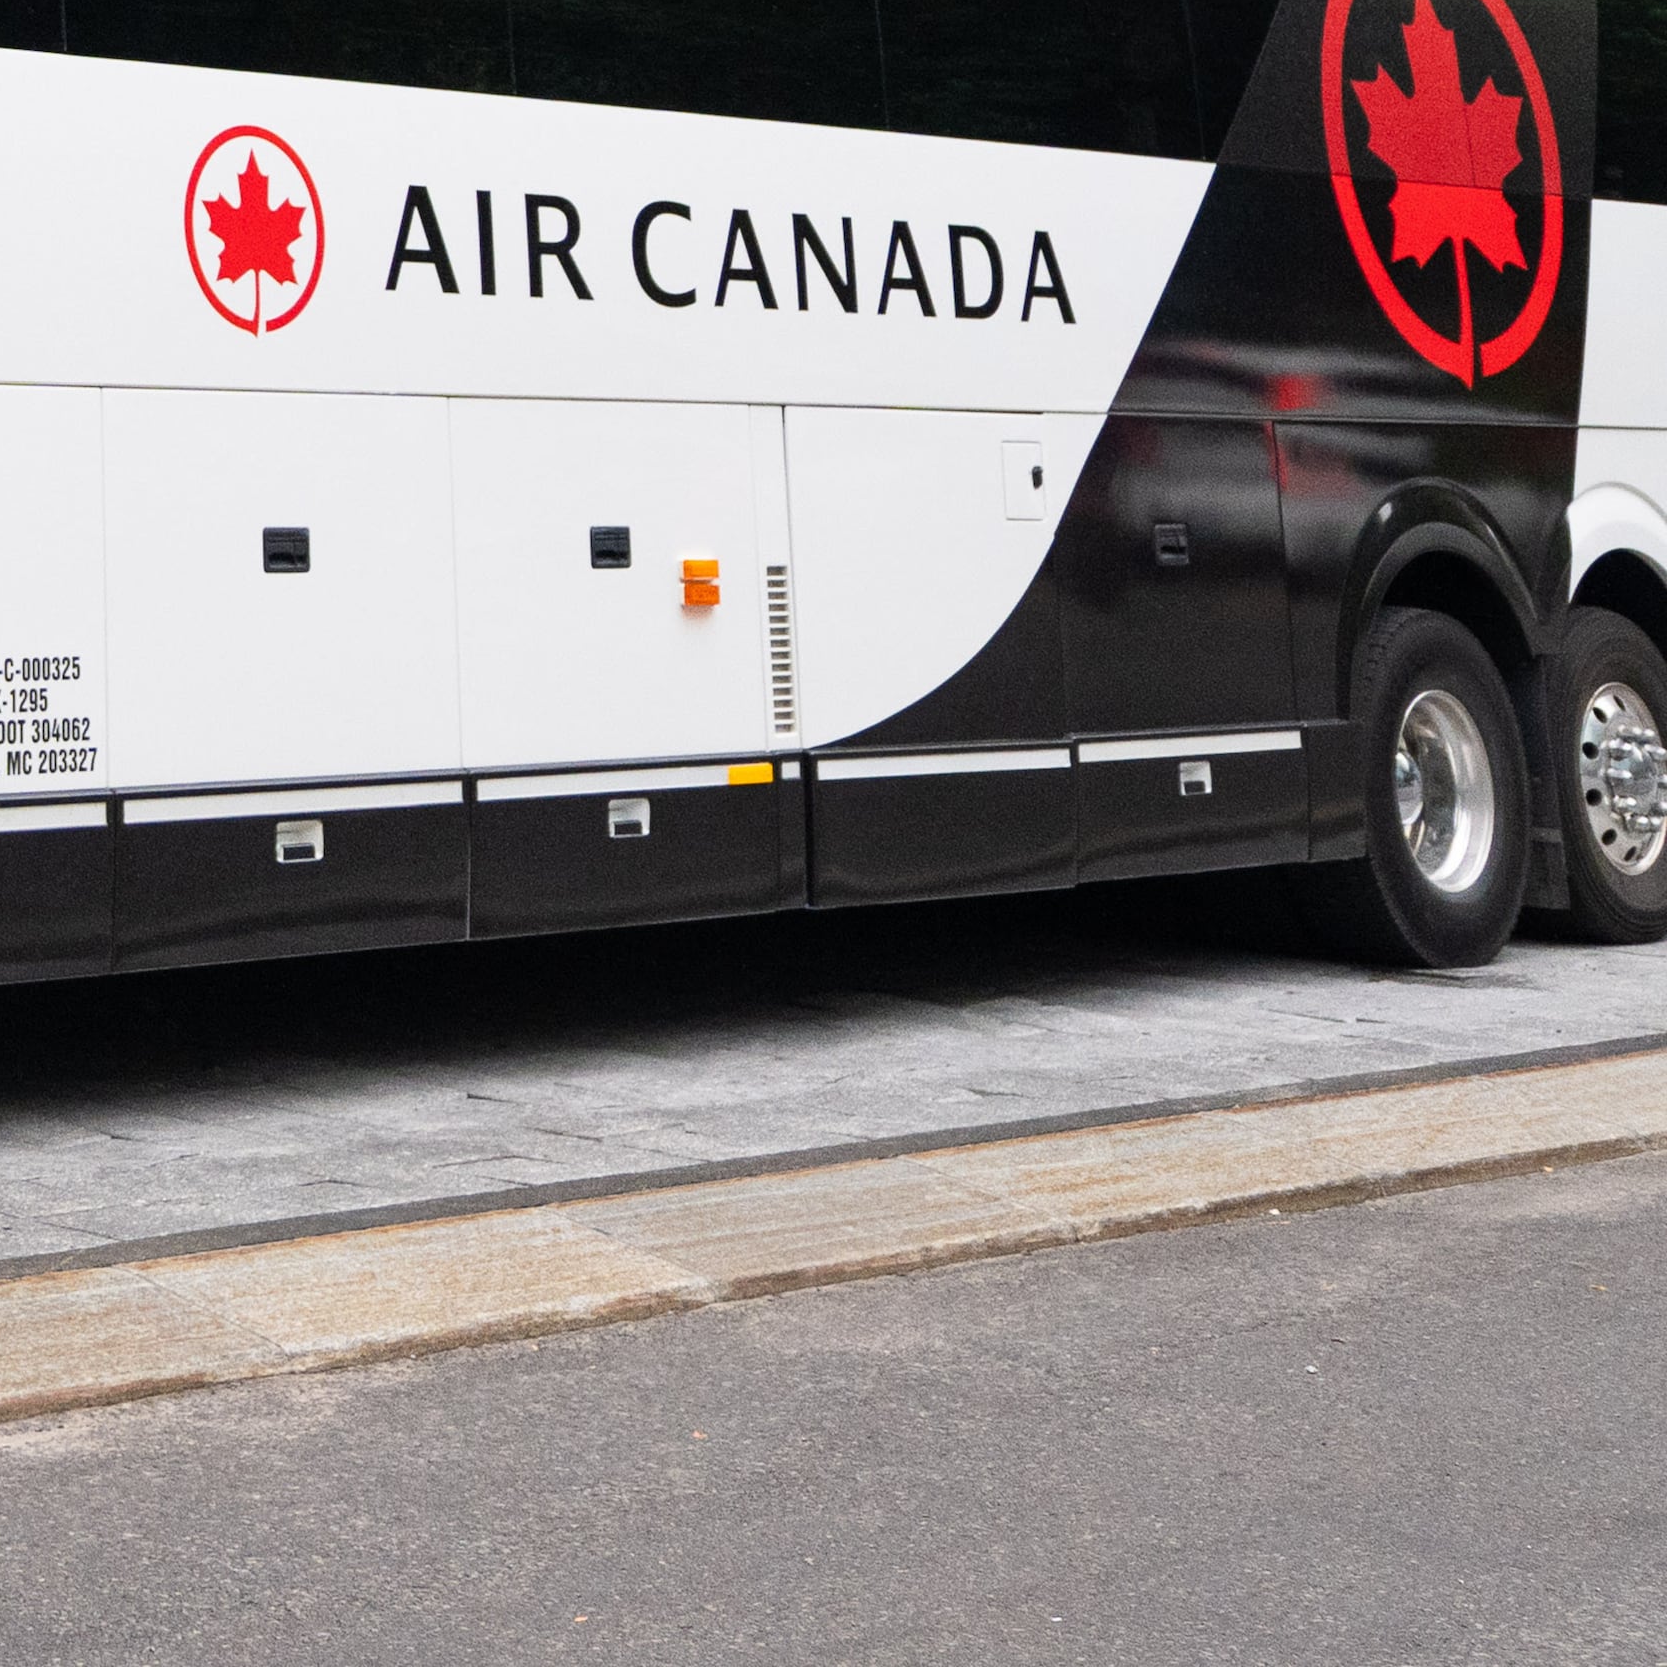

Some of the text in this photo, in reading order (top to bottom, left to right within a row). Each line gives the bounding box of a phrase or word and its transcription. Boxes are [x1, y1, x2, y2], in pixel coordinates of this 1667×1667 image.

[385, 185, 1076, 324] AIR CANADA
[31, 717, 91, 744] 304062
[6, 750, 33, 776] MC
[38, 747, 98, 774] 203327
